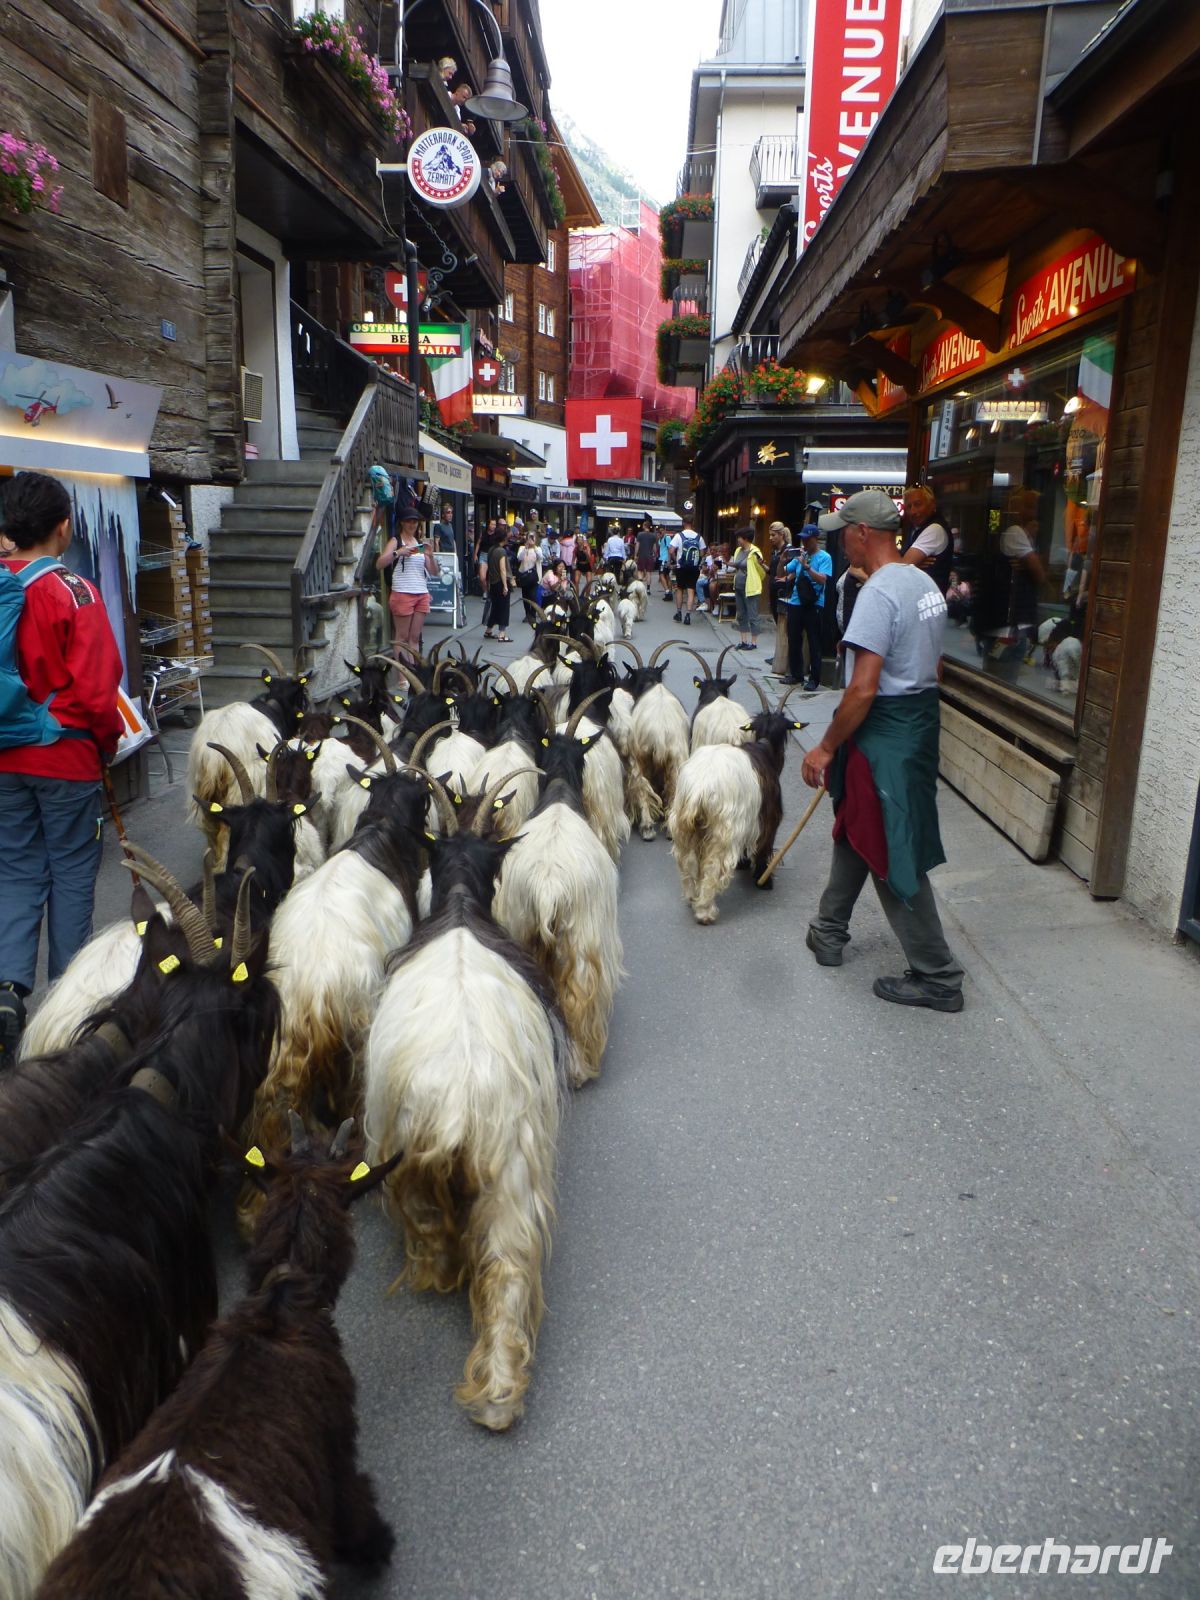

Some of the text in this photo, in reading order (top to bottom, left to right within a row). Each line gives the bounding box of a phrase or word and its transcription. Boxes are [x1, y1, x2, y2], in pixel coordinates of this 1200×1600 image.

[837, 0, 886, 178] VENUE
[414, 131, 474, 164] MATTERHORN SPORT
[427, 171, 456, 186] ZERMATT
[352, 323, 409, 333] OSTERIA
[391, 334, 431, 344] BEA
[418, 345, 457, 355] TALIA
